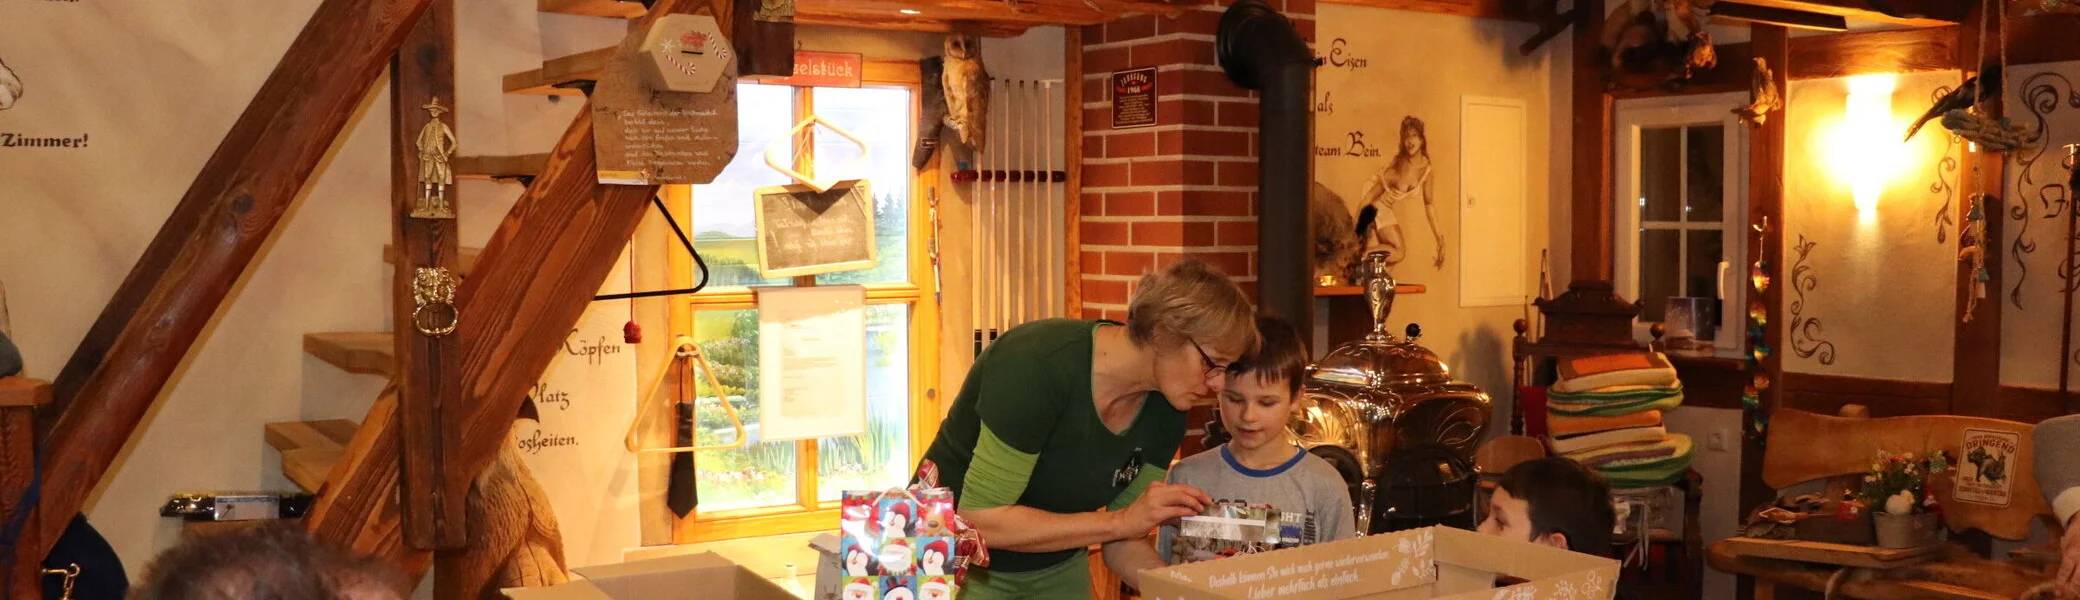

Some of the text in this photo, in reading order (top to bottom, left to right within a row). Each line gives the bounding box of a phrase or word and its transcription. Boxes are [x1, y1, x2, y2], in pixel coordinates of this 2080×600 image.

[1329, 37, 1367, 71] Eisen
[793, 58, 854, 77] zelstück
[1317, 91, 1333, 116] als
[1, 132, 89, 148] Zimmer!
[1345, 130, 1381, 158] Bein.
[517, 429, 579, 455] osheiten.
[1965, 438, 2016, 454] DRINGEND
